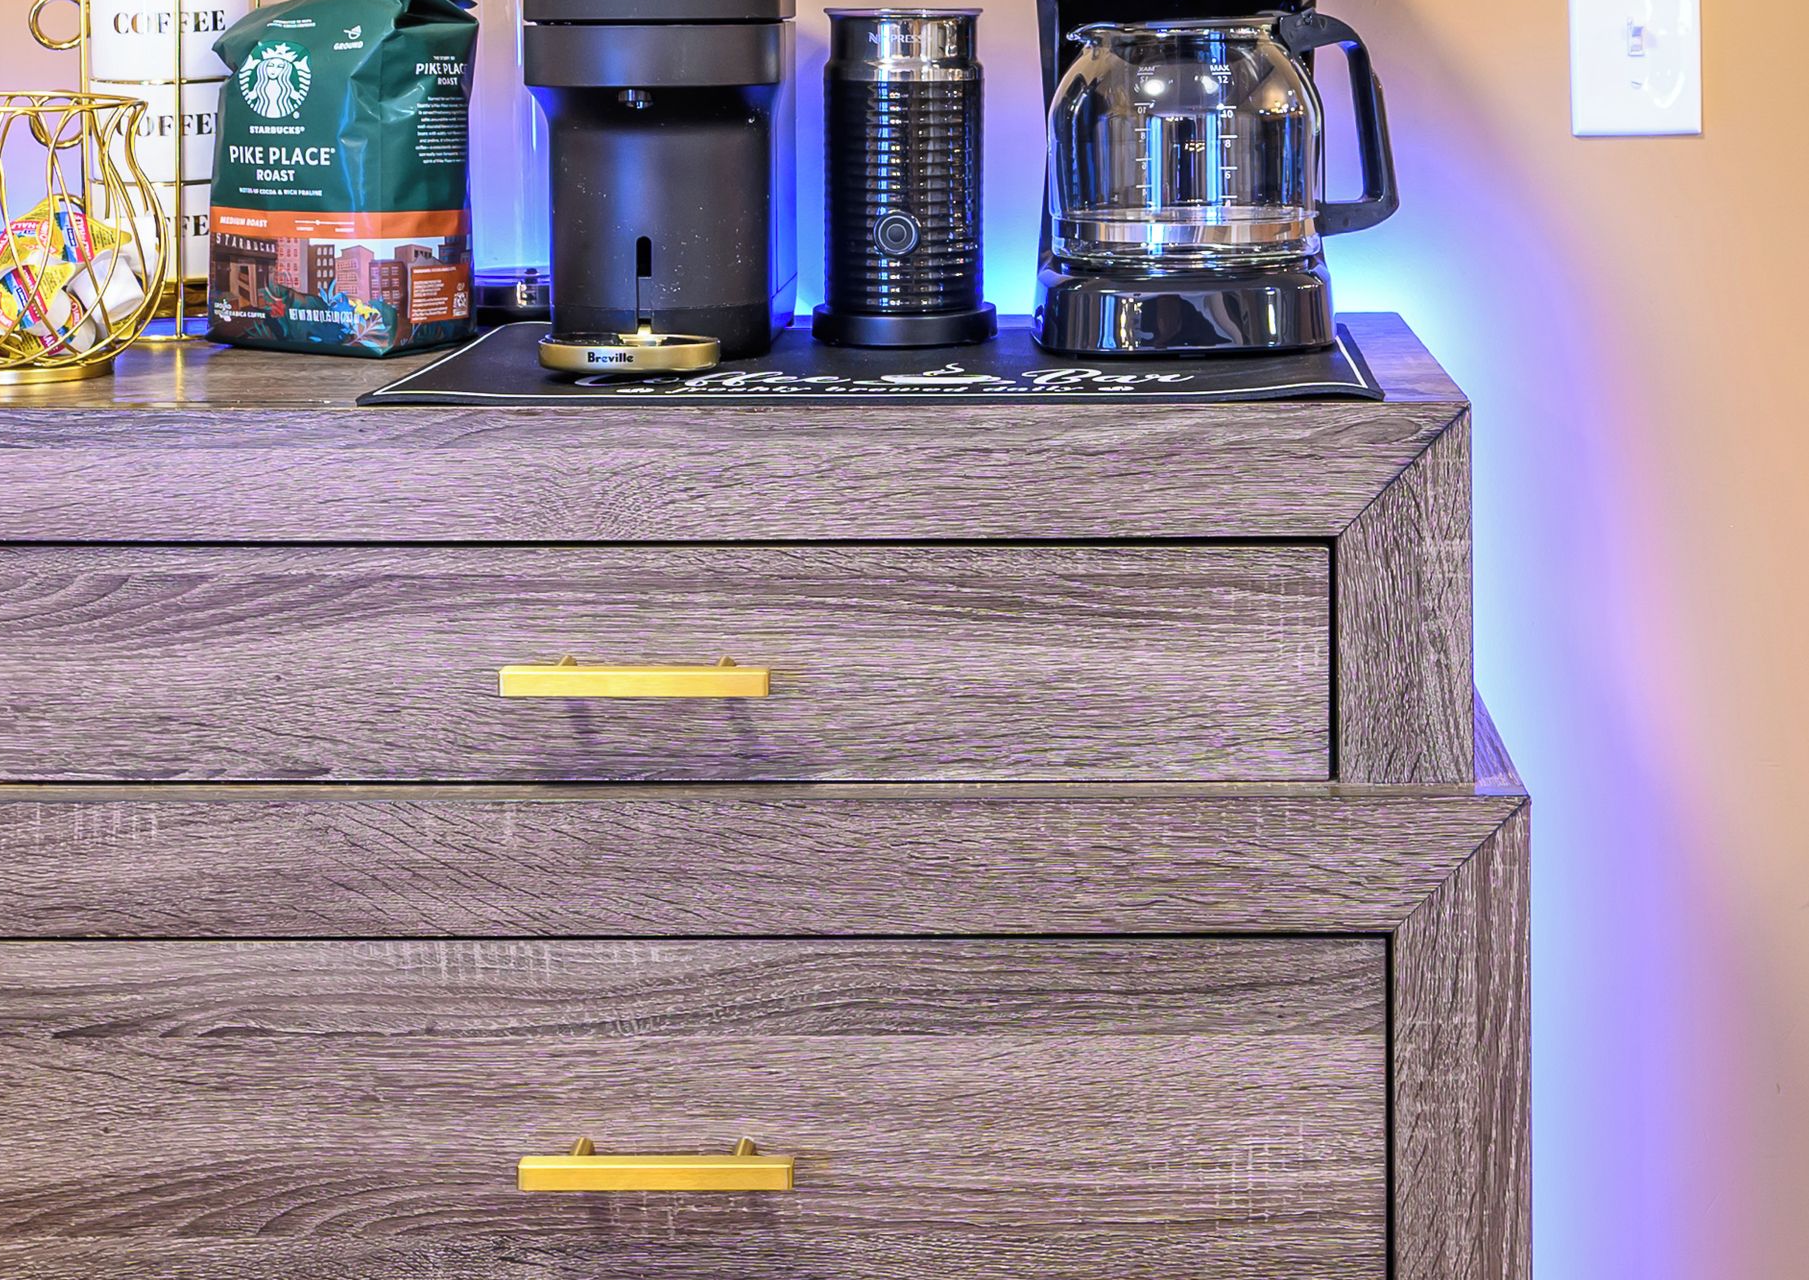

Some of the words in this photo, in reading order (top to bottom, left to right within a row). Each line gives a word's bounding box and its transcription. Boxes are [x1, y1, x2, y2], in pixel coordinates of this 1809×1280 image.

[113, 10, 226, 34] COFFEE
[334, 41, 364, 50] GROUND
[416, 63, 441, 75] PIKE
[437, 77, 458, 86] ROAST
[1218, 76, 1229, 84] 12
[1221, 110, 1233, 118] 10
[115, 113, 218, 137] COFFE
[1225, 140, 1231, 148] 8
[229, 145, 264, 164] PIKE
[269, 147, 331, 166] PLACE
[256, 169, 295, 182] ROAST
[1225, 171, 1231, 179] 6
[220, 216, 246, 226] MEDIUM
[246, 218, 268, 228] ROAST
[216, 232, 276, 254] STARBUCKS
[587, 352, 634, 363] Breville
[1022, 368, 1195, 385] Bar
